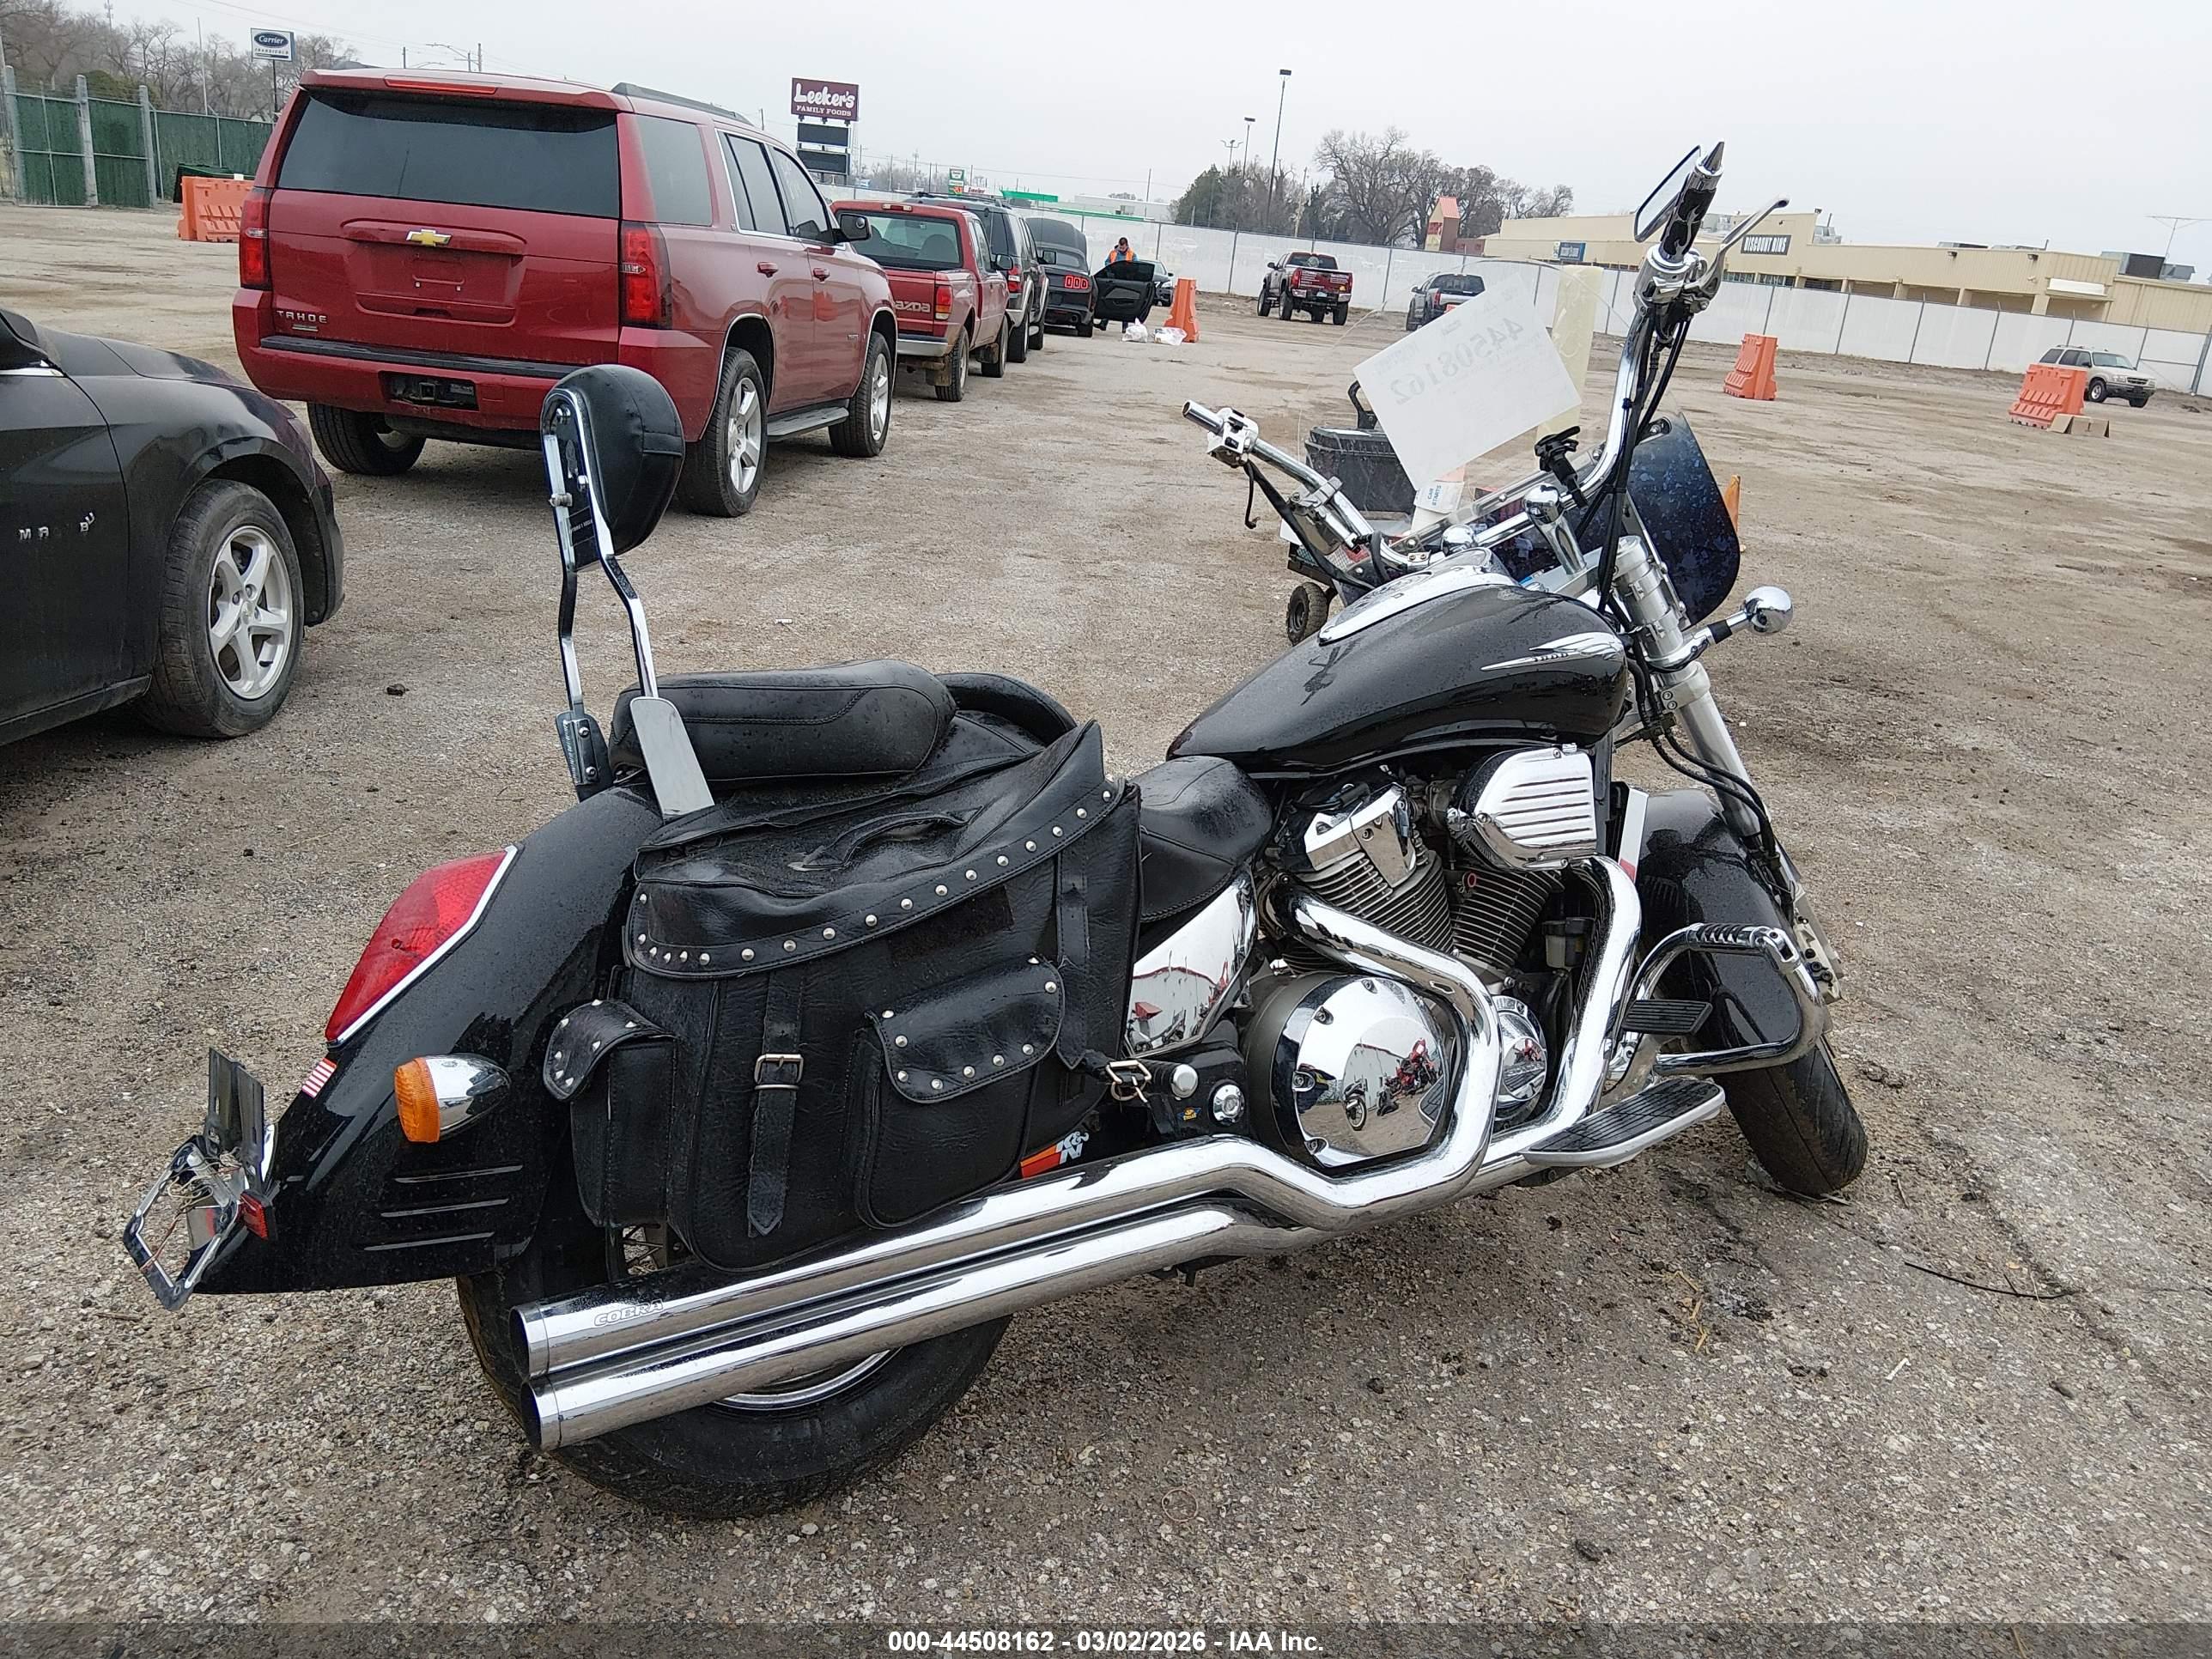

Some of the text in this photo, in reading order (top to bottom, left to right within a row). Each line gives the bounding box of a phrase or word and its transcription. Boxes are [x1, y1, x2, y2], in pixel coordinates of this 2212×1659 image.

[258, 35, 284, 44] Carrier
[793, 82, 856, 109] Leeker's
[796, 105, 852, 117] FAMILY FOODS
[1744, 236, 1773, 252] DISCOUNT
[895, 301, 931, 313] azda
[276, 310, 328, 324] TAHOE
[1054, 1131, 1090, 1165] K&N
[594, 1298, 664, 1327] COBRA
